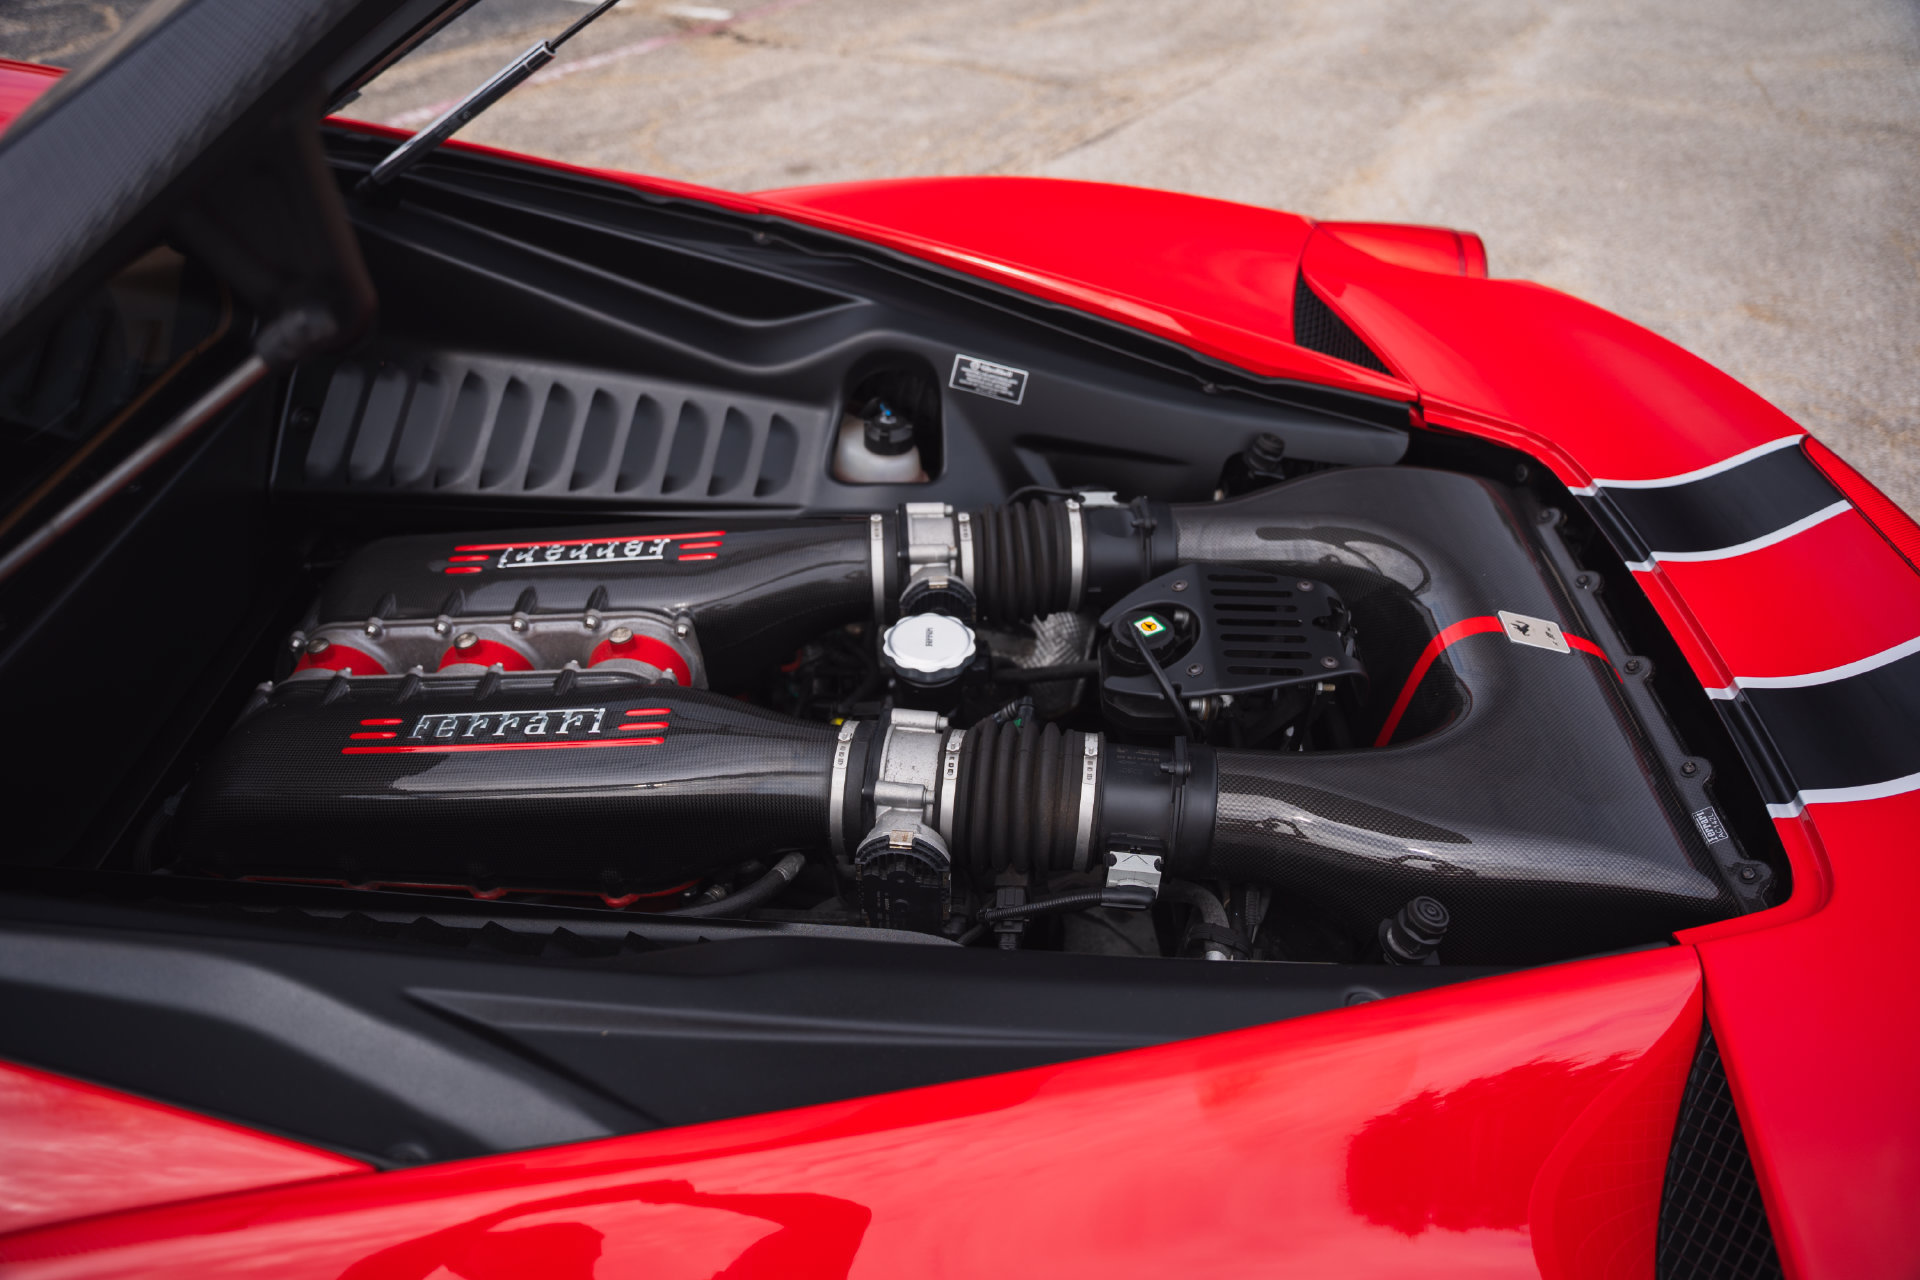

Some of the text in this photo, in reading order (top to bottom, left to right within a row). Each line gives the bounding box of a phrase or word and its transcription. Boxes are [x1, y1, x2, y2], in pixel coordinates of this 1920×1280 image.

[498, 538, 670, 568] Ferrari
[407, 708, 606, 739] Ferrari
[1695, 811, 1719, 843] Ferrari
